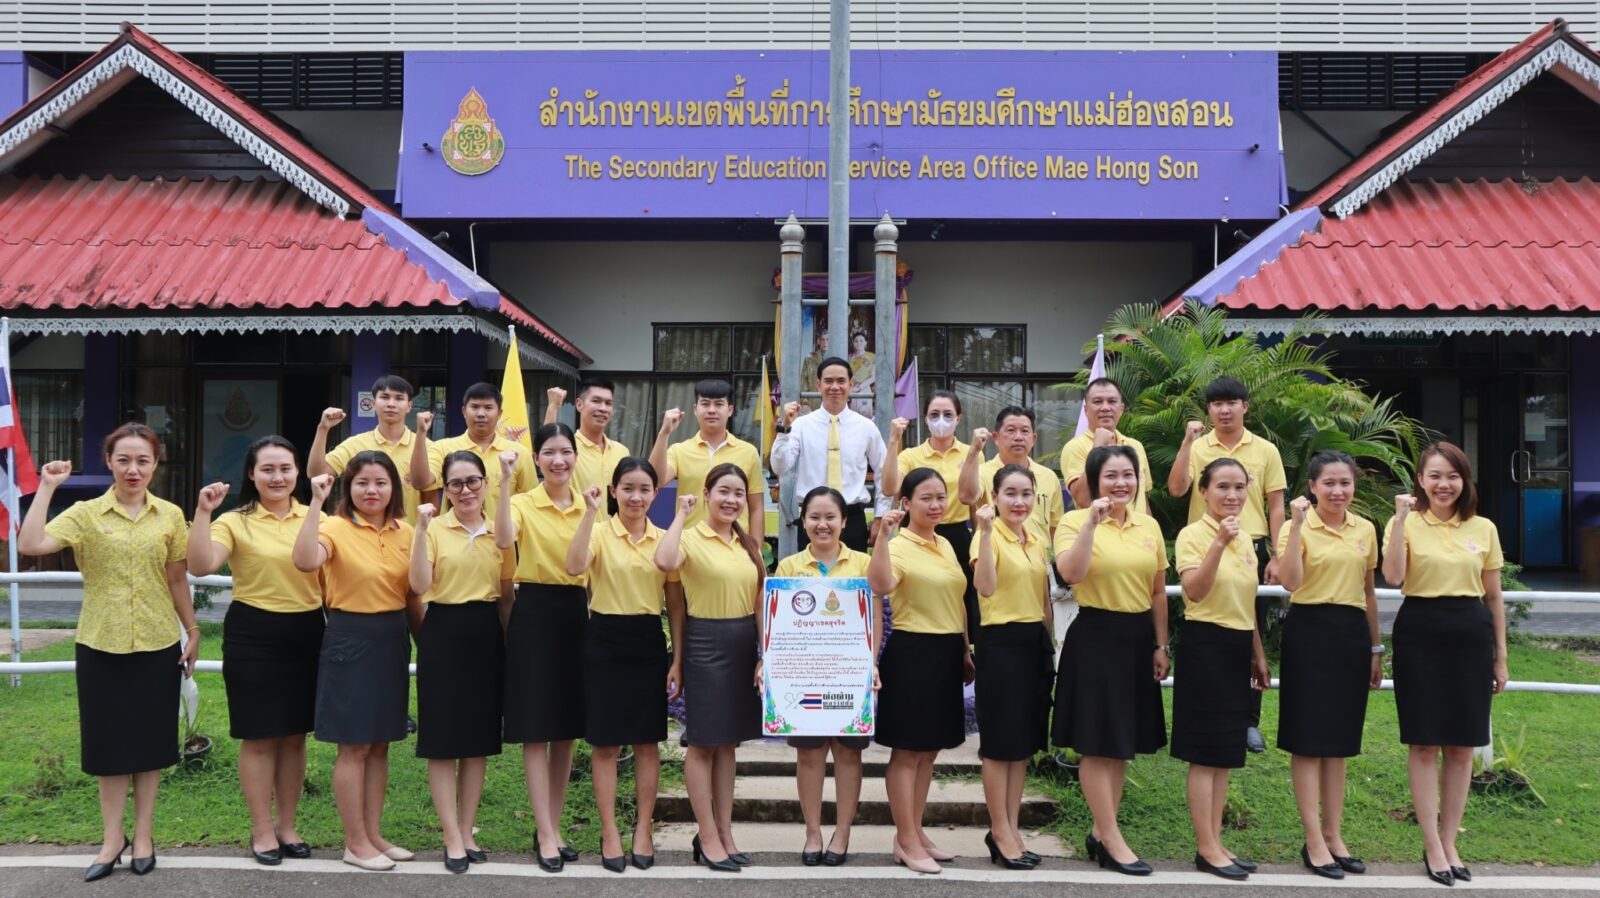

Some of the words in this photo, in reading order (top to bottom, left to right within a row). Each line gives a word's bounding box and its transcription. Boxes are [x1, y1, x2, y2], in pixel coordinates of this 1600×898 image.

[565, 154, 602, 179] The
[608, 154, 718, 184] Secondary
[724, 154, 827, 179] Education
[848, 154, 912, 179] ervice
[918, 154, 966, 179] Area
[972, 154, 1038, 179] Office
[1045, 154, 1088, 179] Mae
[1096, 154, 1150, 185] Hong
[1158, 154, 1199, 179] Son
